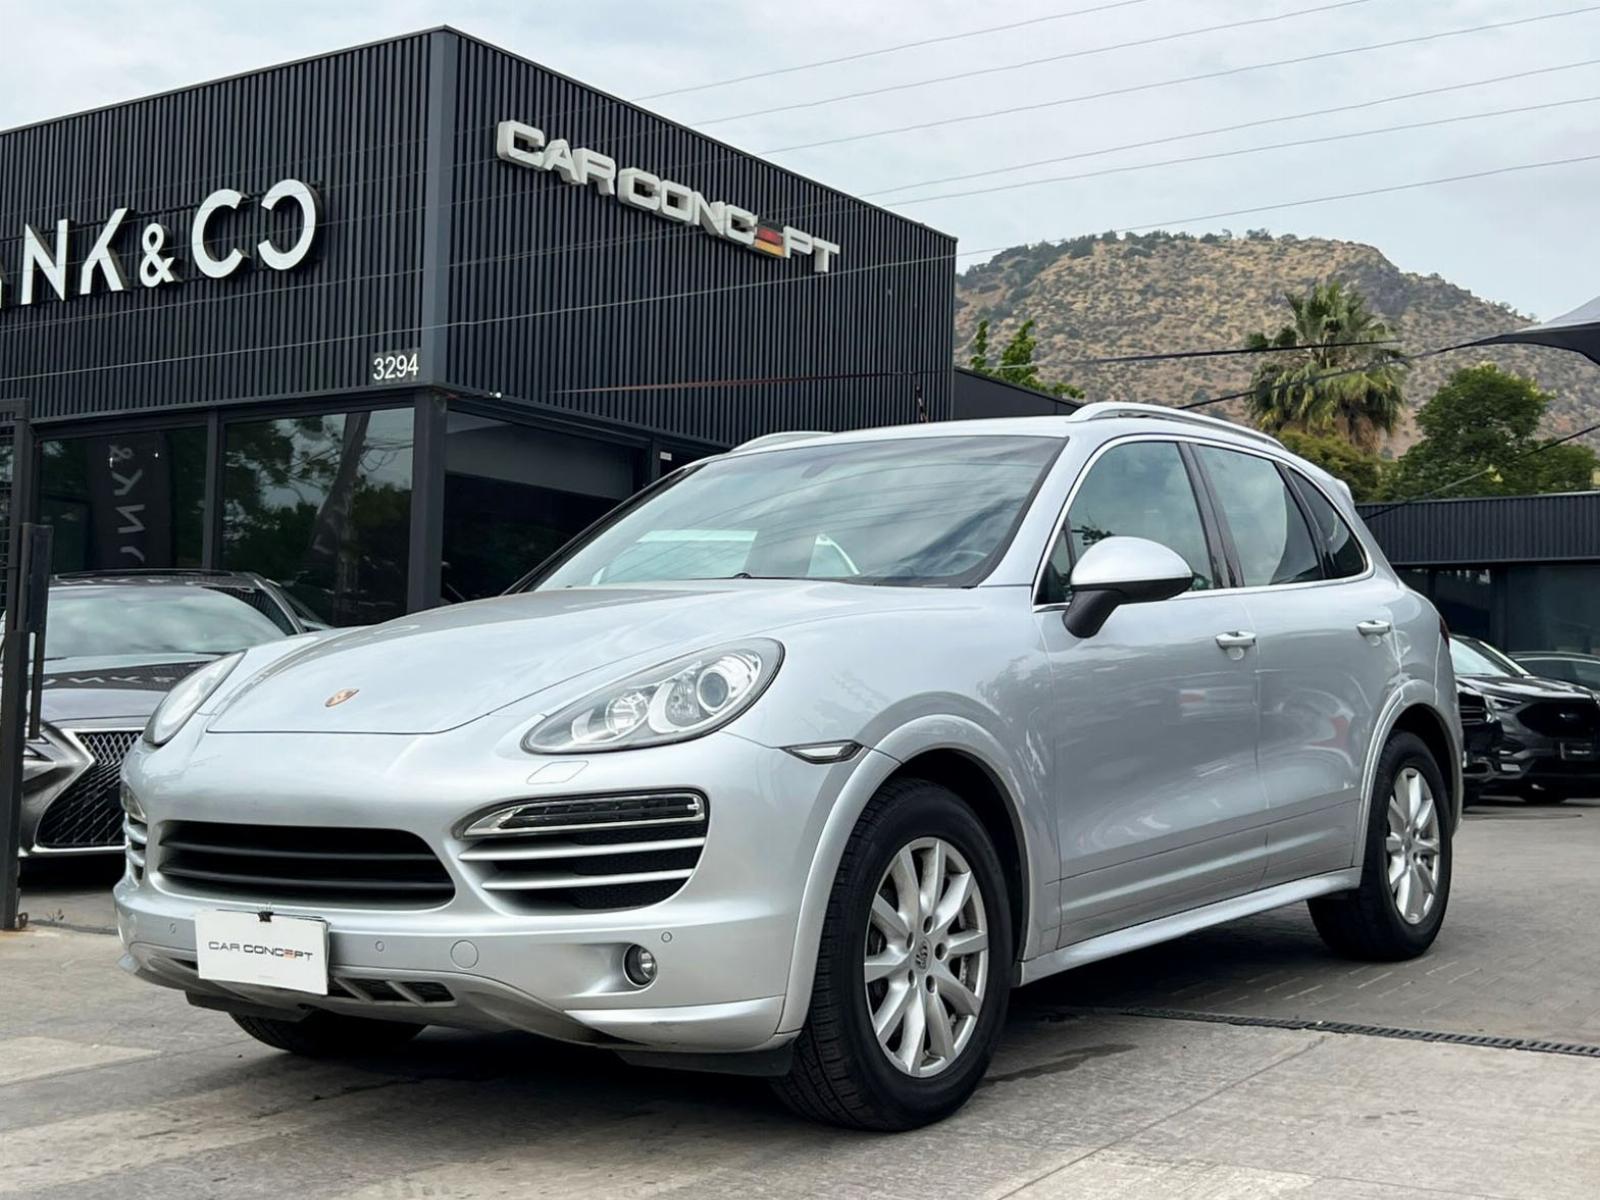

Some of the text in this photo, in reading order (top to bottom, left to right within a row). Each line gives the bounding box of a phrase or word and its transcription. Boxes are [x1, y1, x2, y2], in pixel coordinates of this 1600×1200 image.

[496, 119, 616, 196] CAR
[373, 353, 419, 380] 3294
[208, 941, 314, 961] CAR CONCEPT
